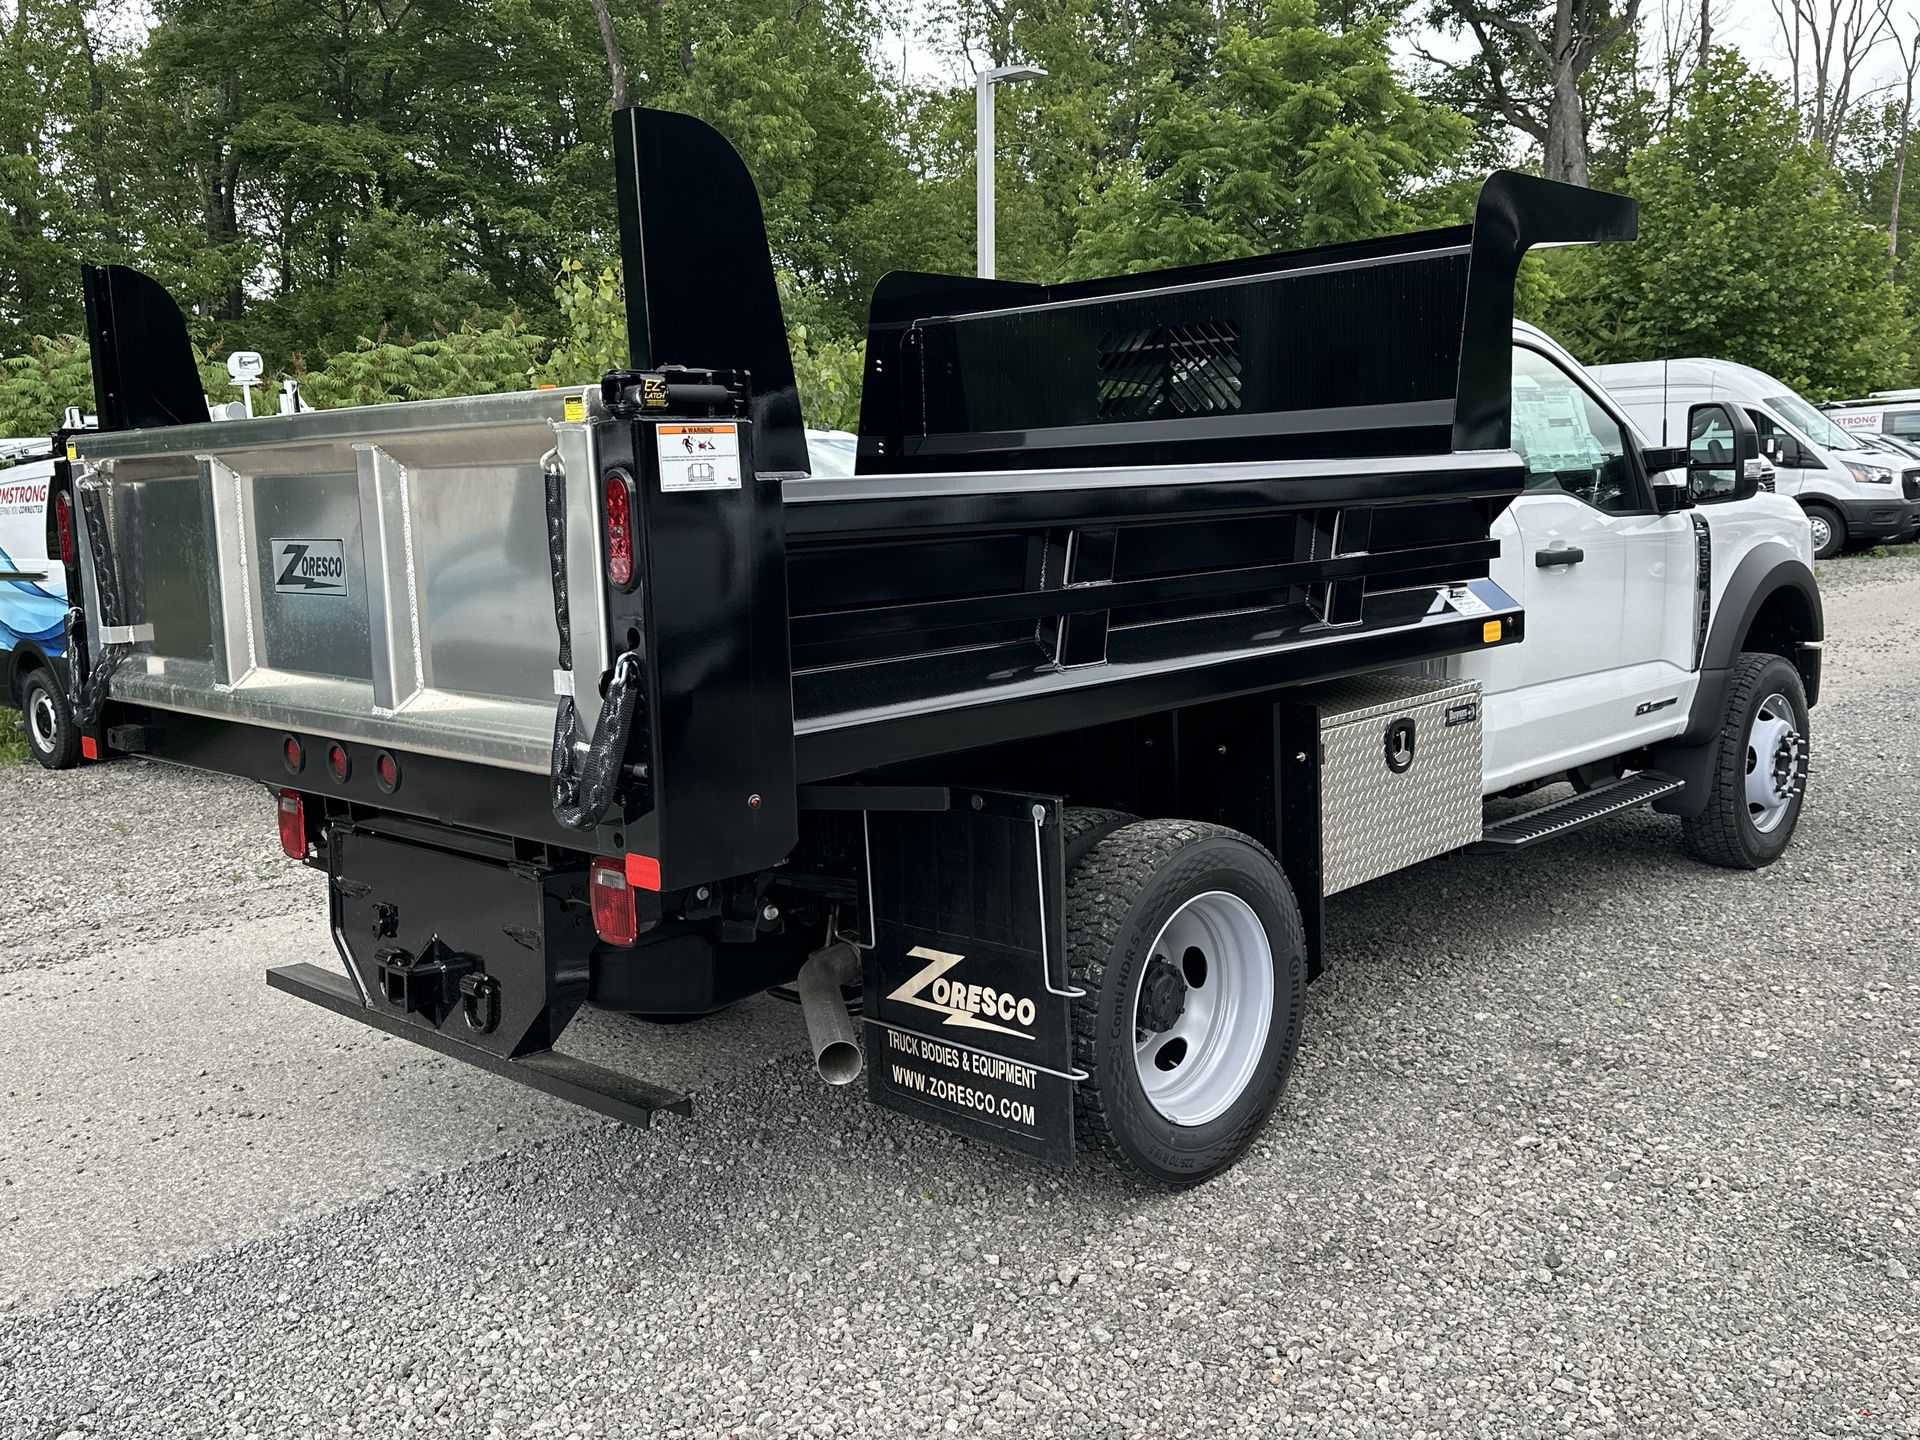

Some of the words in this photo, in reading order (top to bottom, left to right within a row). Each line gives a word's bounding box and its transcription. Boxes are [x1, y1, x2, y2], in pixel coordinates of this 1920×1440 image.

[644, 391, 666, 399] LATCH
[276, 544, 343, 589] ZORESCO
[886, 945, 1036, 1040] ZORESCO
[1111, 991, 1125, 1039] Conti
[1118, 948, 1136, 988] HDR
[1131, 934, 1141, 948] 5
[1273, 955, 1302, 1083] Continental
[887, 1029, 919, 1056] TRUCK
[921, 1040, 959, 1068] BODIES
[962, 1051, 970, 1072] &
[972, 1053, 1037, 1090] EQUIPMENT
[892, 1064, 1035, 1126] WWW.ZORESCO.COM
